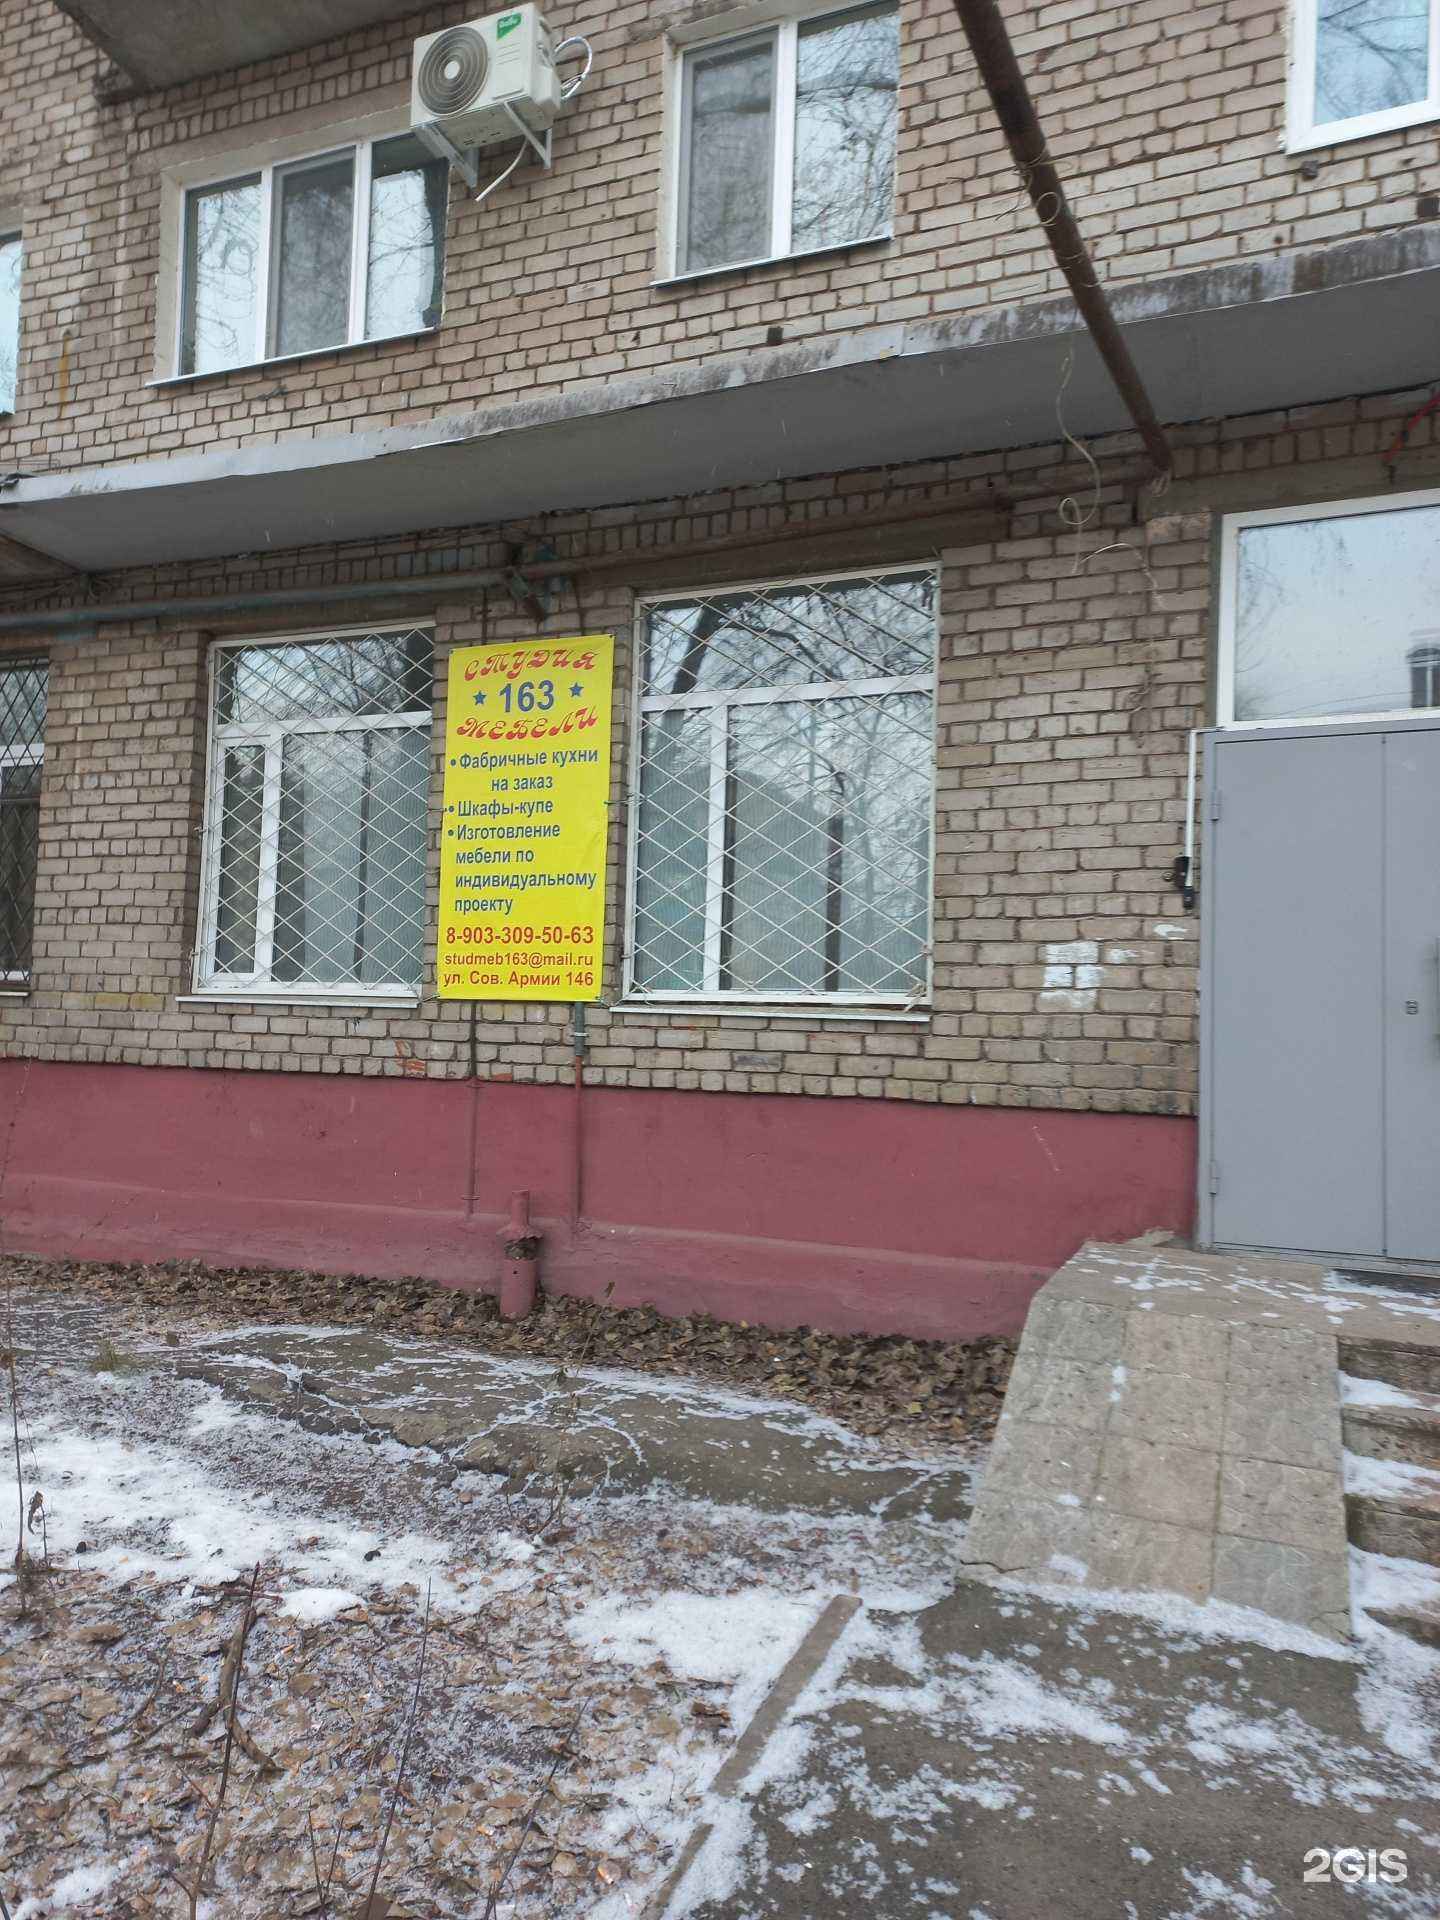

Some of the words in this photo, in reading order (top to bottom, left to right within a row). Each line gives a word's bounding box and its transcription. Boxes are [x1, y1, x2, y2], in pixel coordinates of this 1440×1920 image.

[464, 648, 598, 681] СТУДИЯ
[498, 679, 554, 714] 163
[457, 707, 598, 740] МЕБЕЛИ
[460, 750, 547, 770] Фабричные
[552, 748, 598, 765] кухни
[491, 777, 508, 791] на
[513, 776, 553, 790] заказ
[458, 800, 553, 819] Шкафы-купе
[457, 824, 560, 839] Изготовление
[456, 848, 511, 864] мебели
[516, 850, 534, 864] по
[455, 873, 596, 891] индивидуальному
[455, 899, 514, 914] проекту
[446, 926, 594, 944] 8-903-309-50-63
[445, 953, 593, 968] studmeb163@mail.ru
[444, 973, 464, 987] ул.
[469, 971, 503, 985] Сов.
[508, 971, 560, 988] Армии
[566, 972, 593, 986] 146
